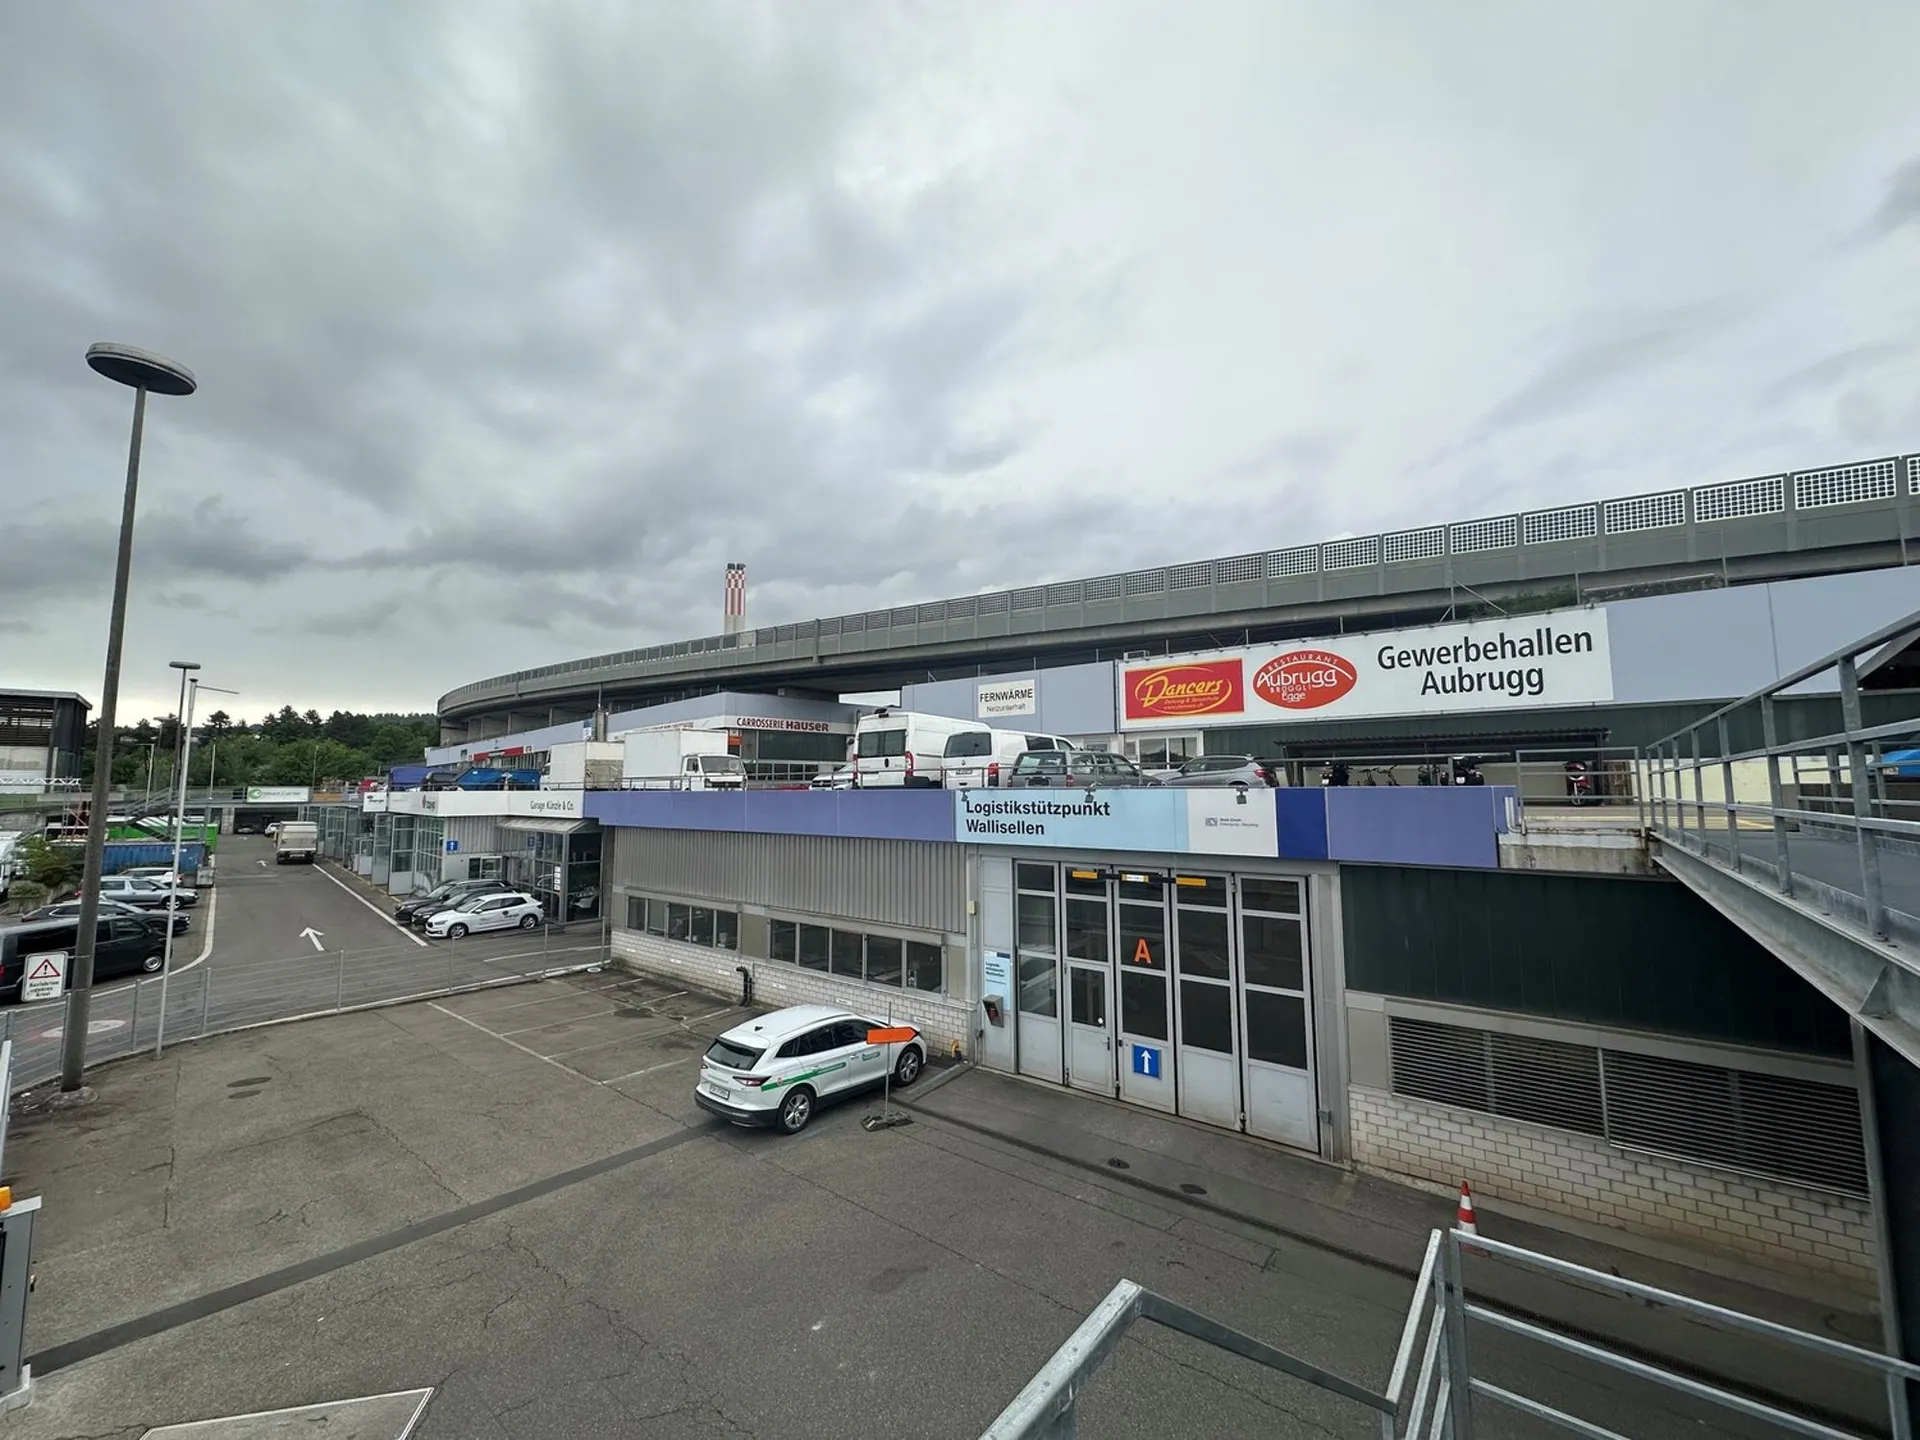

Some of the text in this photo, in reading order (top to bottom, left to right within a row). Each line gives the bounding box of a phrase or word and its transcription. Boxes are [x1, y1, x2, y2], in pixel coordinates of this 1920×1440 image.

[1377, 627, 1593, 669] Gewerbehallen
[1268, 653, 1338, 671] RESTAURANT
[1257, 669, 1337, 688] Aubrugg
[1421, 666, 1544, 697] Aubrugg
[980, 688, 1033, 702] FERNWÄRME
[1141, 676, 1223, 707] Dancers
[1282, 692, 1306, 703] Egge
[737, 717, 784, 729] CARROSSERIE
[966, 800, 1110, 818] Logistikstützpunkt
[966, 819, 1044, 835] Wallisellen
[1134, 938, 1152, 964] A
